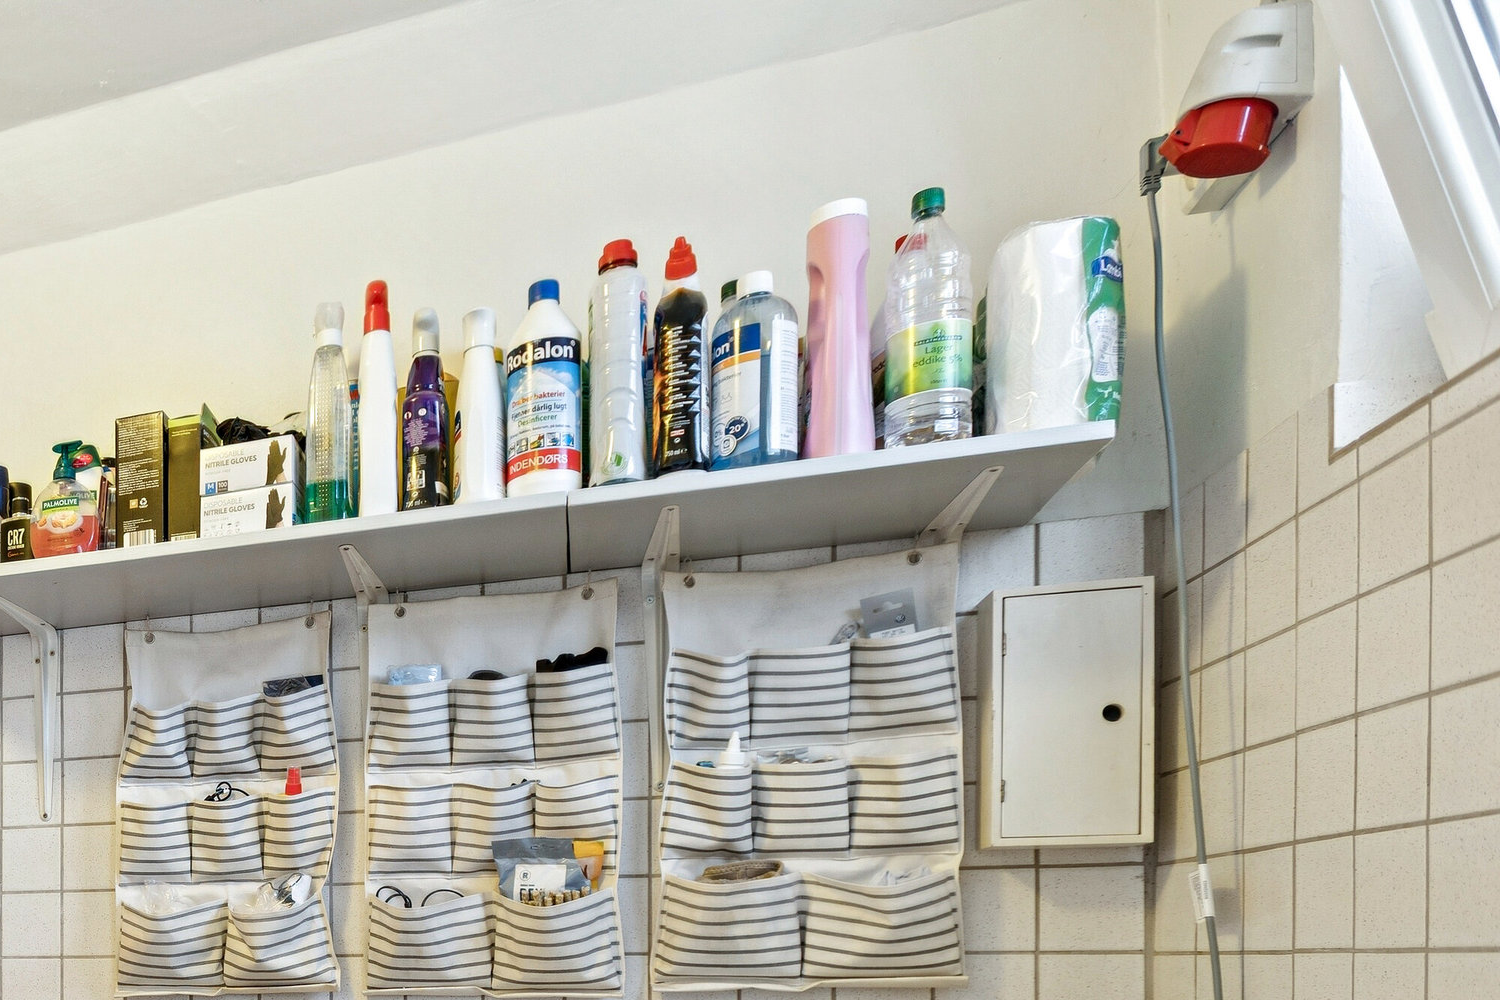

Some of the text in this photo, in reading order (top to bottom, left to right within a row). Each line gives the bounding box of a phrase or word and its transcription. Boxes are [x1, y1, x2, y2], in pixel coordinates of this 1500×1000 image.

[925, 344, 953, 354] Lager
[913, 355, 946, 368] eddike
[205, 455, 257, 469] NITRILE GLOVES
[509, 453, 568, 475] INDENDØRS
[43, 498, 78, 509] PALMOLIVE
[203, 503, 255, 517] NITRILE GLOVES
[7, 528, 25, 546] CR7
